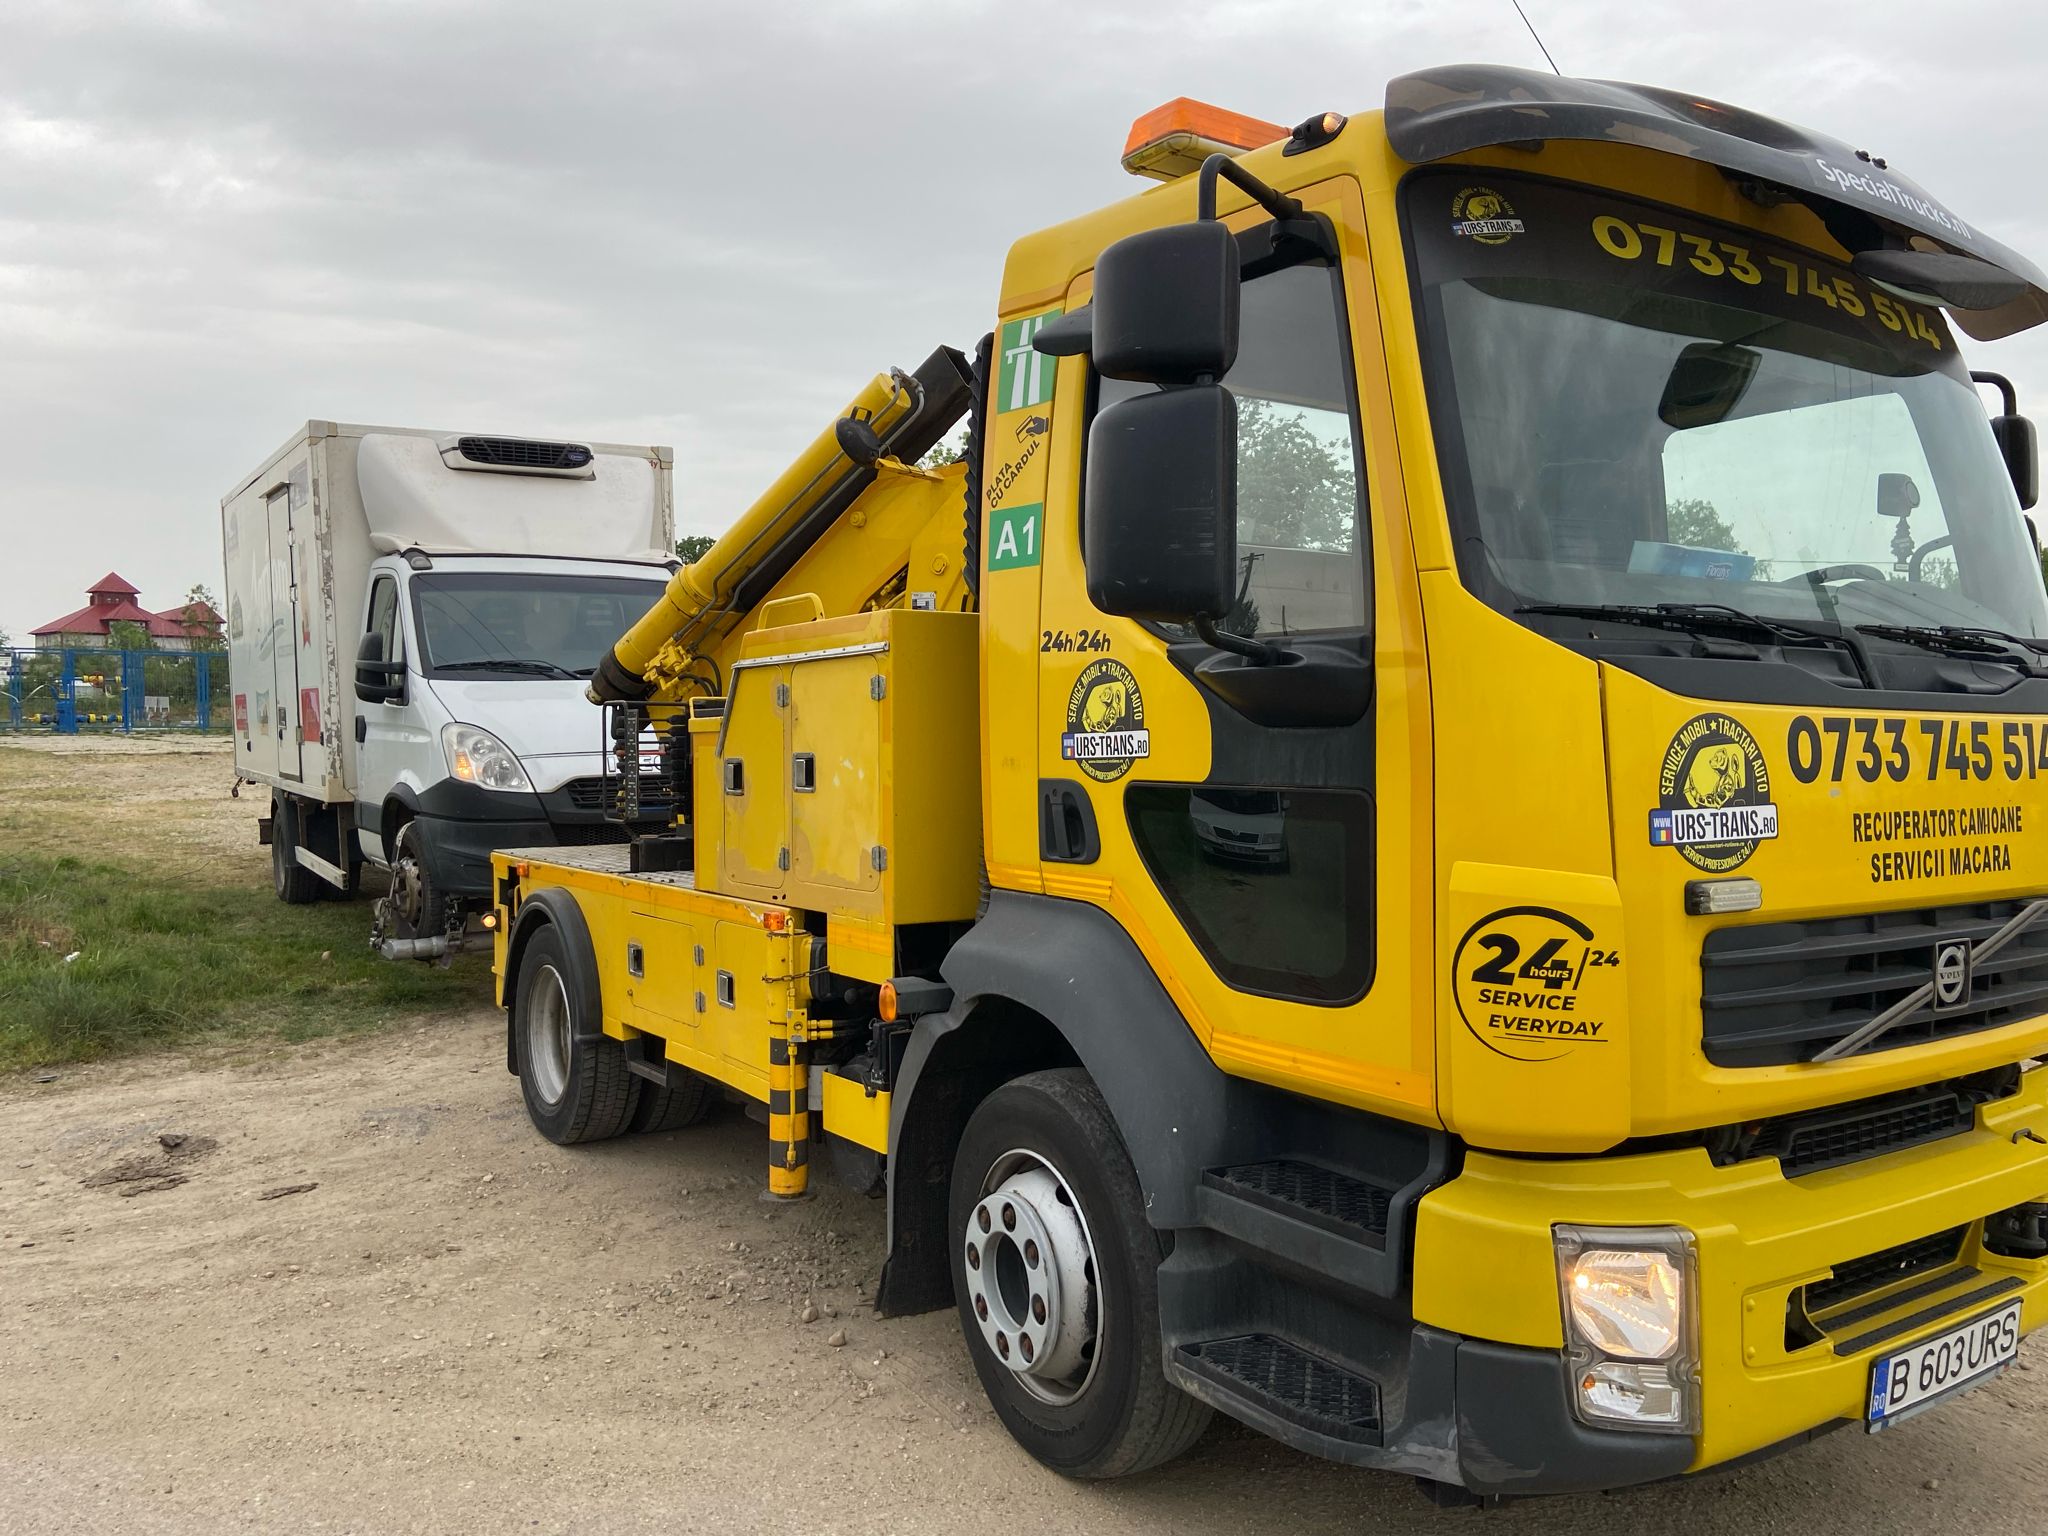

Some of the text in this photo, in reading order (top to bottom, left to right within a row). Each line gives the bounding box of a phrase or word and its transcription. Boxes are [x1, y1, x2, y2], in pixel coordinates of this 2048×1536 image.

[1816, 158, 1972, 240] SpecialTrucks.nl
[1592, 215, 1762, 285] 0733
[1767, 256, 1866, 317] 745
[1872, 291, 1942, 350] 514
[986, 462, 1012, 501] PLATA
[991, 440, 1040, 508] CU CARDUL
[995, 515, 1035, 559] A1
[1041, 629, 1111, 652] 24h/24h
[1068, 662, 1143, 723] SERVICE MOBIL TRACTARI AUTO
[1076, 734, 1148, 757] URS-TRANS.RO
[1662, 718, 1769, 796] SERVICE MOBIL TRACTARI AUTO
[1787, 715, 1910, 784] 0733
[1920, 719, 1993, 781] 745
[1674, 809, 1777, 841] URS-TRANS.RO
[1852, 805, 2023, 843] RECUPERATOR CAMIOANE
[1871, 844, 2012, 883] SERVICII MACARA
[1529, 965, 1570, 979] hours
[1478, 988, 1577, 1011] SERVICE
[1488, 1014, 1604, 1036] EVERYDAY
[1873, 1311, 2017, 1413] RO B 603 URS
